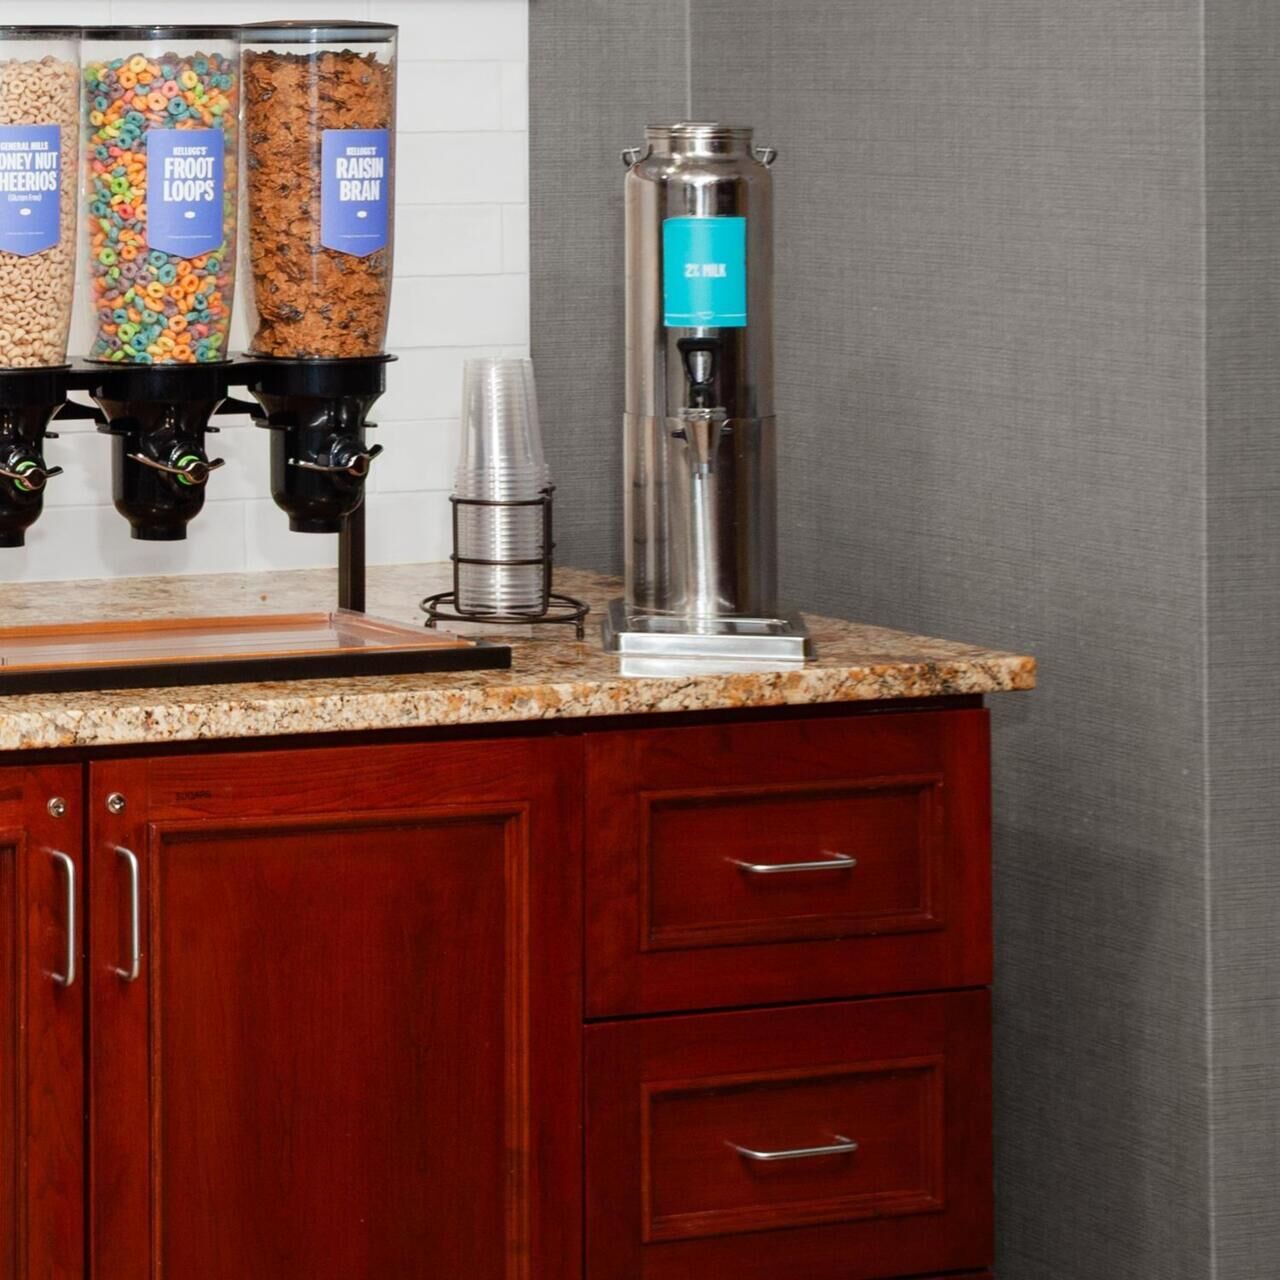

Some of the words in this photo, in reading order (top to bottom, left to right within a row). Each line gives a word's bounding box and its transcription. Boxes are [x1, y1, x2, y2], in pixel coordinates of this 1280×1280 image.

[35, 152, 58, 169] NUT
[164, 157, 214, 179] FROOT
[336, 157, 384, 179] RAISIN
[163, 180, 214, 202] LOOPS
[339, 180, 381, 201] BRAN
